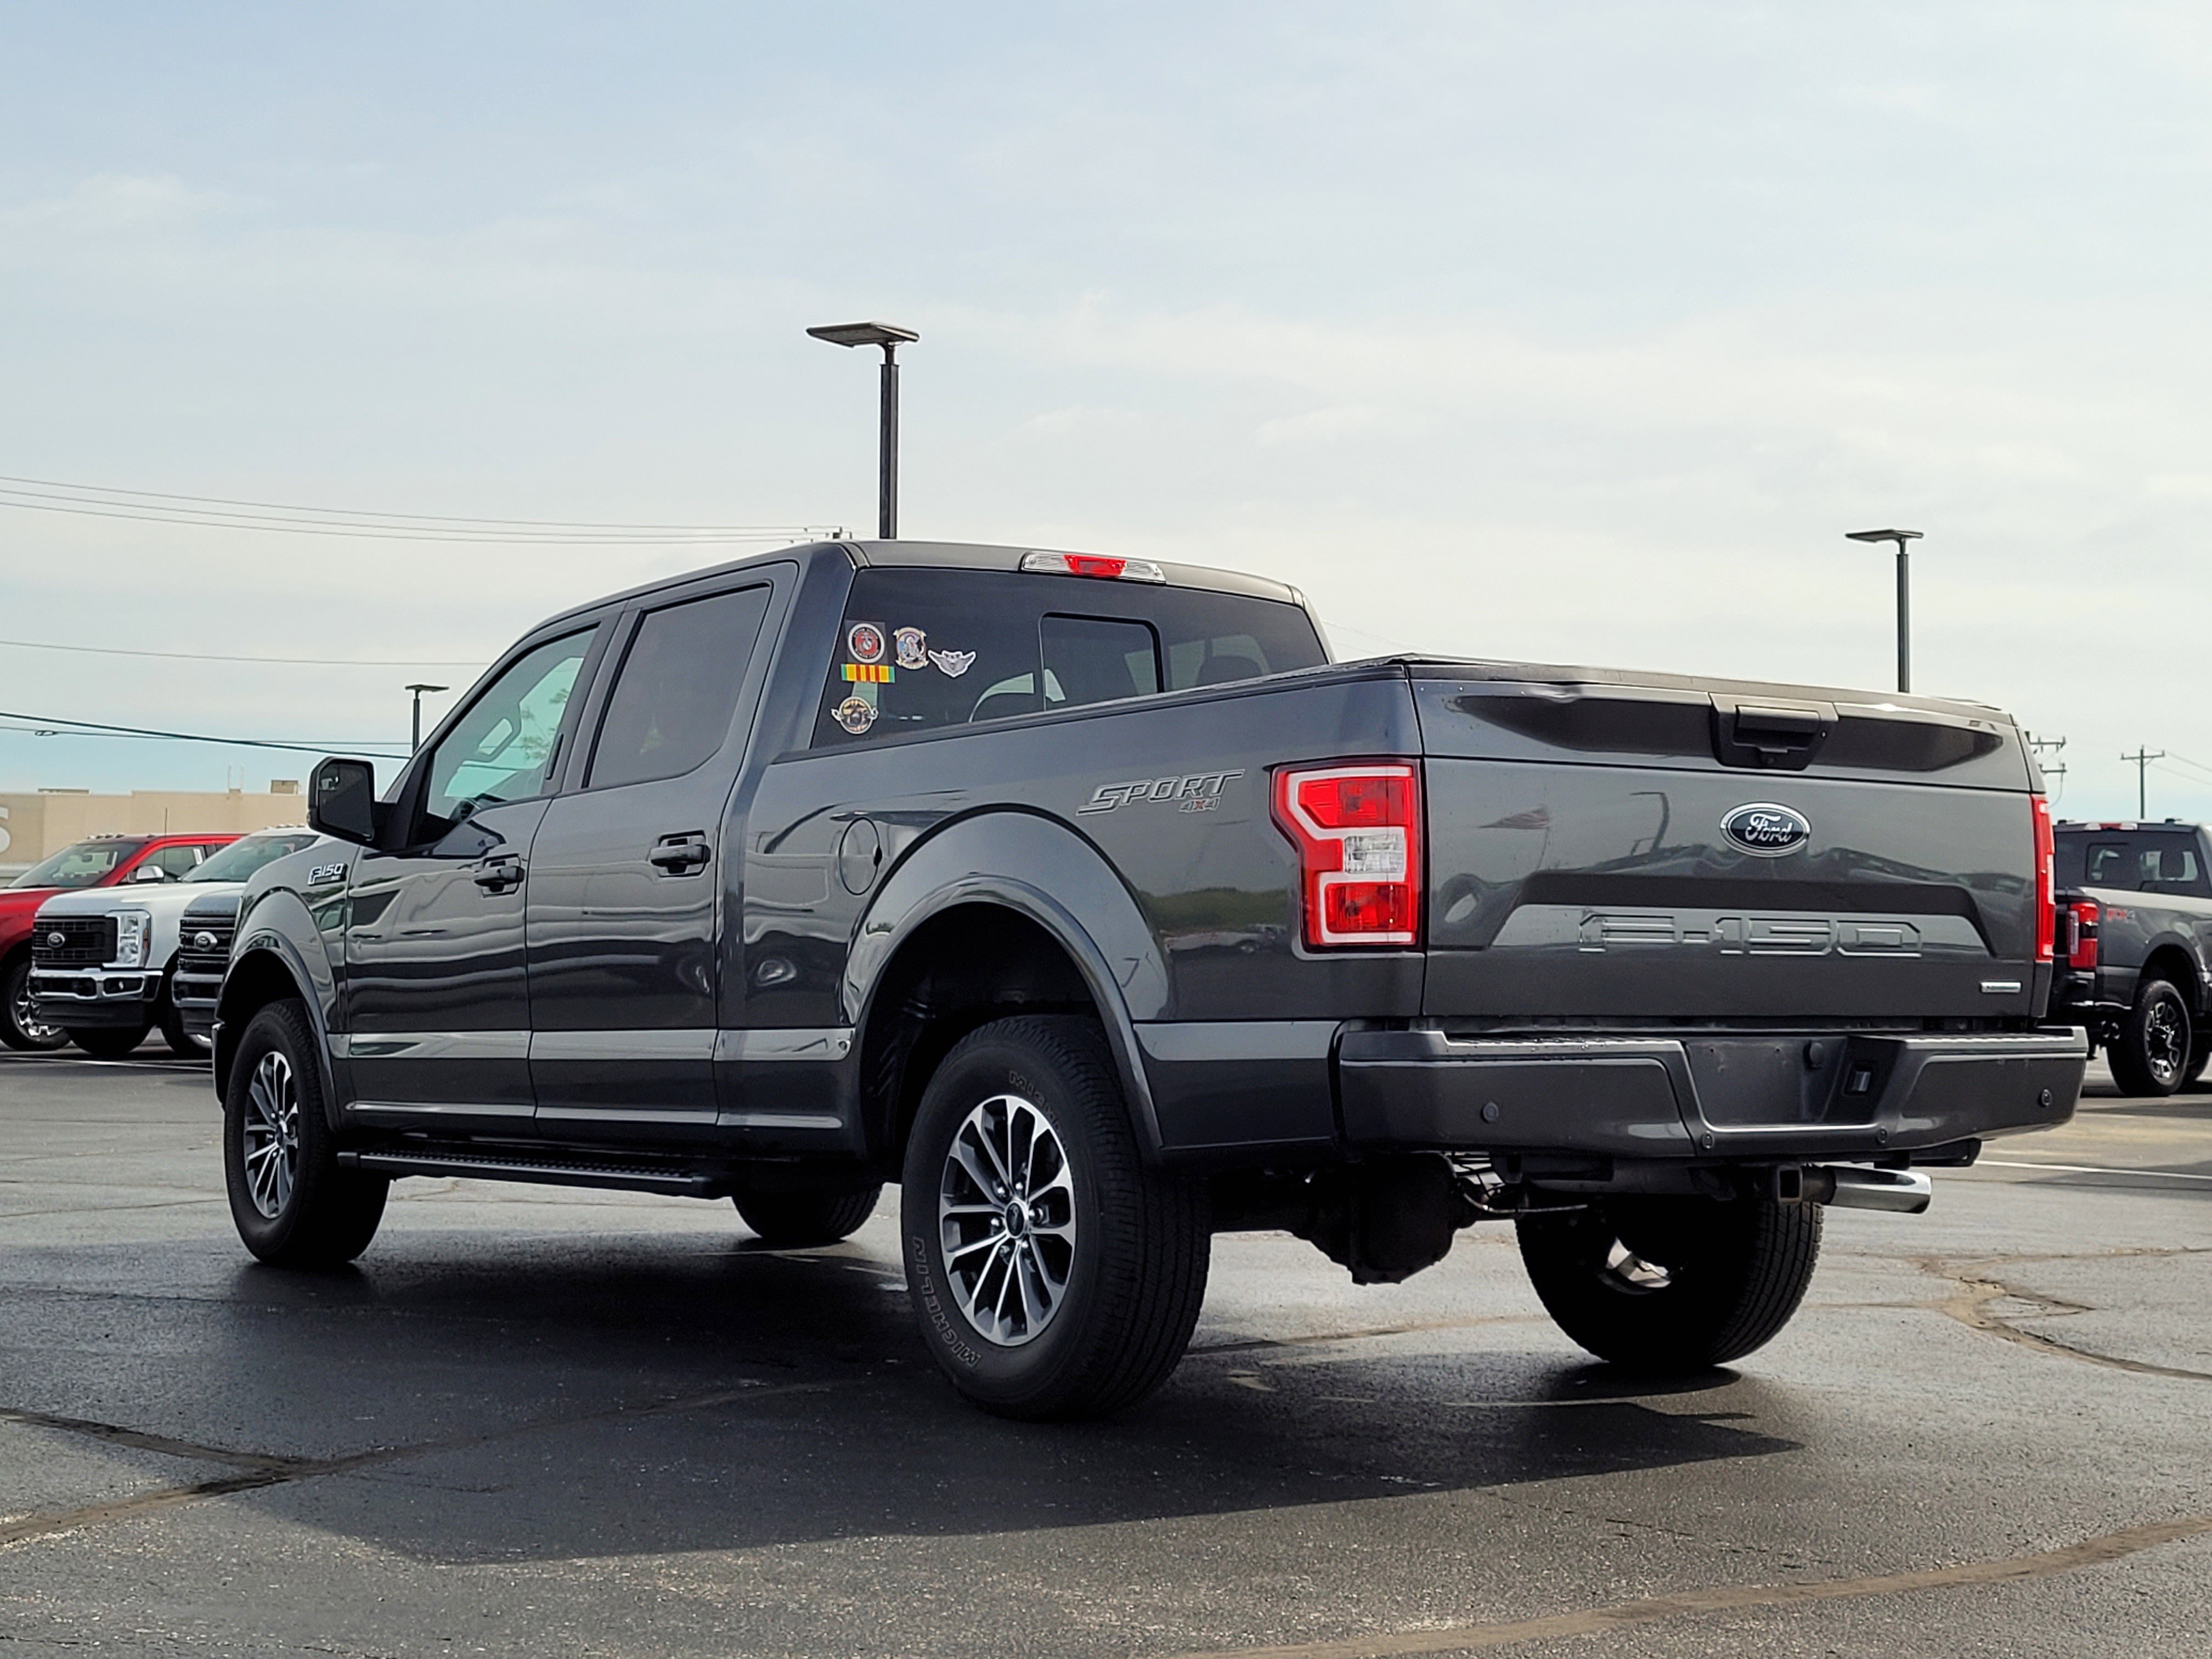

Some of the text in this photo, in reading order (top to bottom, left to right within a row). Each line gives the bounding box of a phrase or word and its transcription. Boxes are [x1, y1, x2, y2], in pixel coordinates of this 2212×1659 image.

[1076, 769, 1246, 816] SPORT
[1745, 813, 1793, 843] Ford
[1578, 913, 1922, 957] F-150
[913, 1237, 981, 1368] MICHELIN
